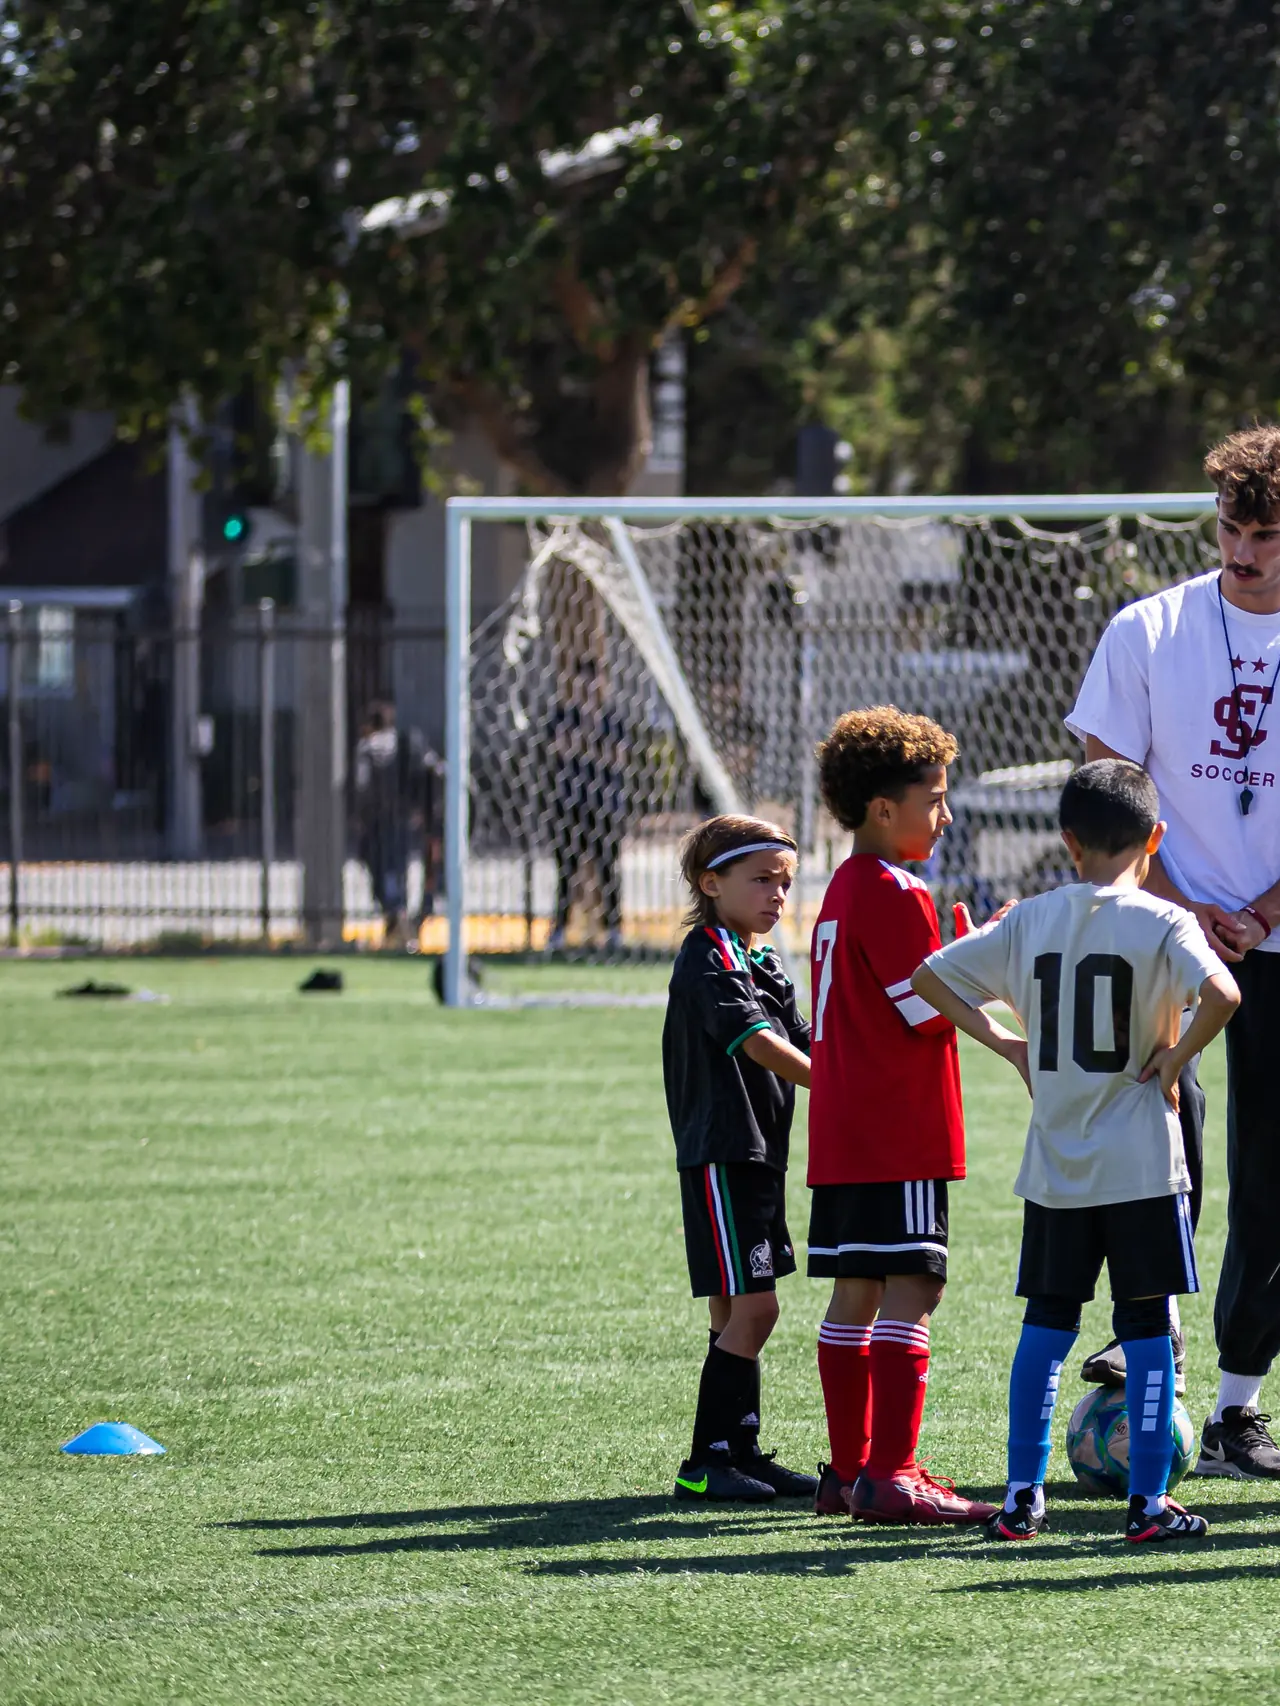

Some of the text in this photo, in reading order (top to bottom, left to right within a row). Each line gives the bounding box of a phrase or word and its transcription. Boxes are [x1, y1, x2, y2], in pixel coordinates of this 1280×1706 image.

[1190, 763, 1276, 787] SOCCER
[814, 919, 838, 1042] 7
[1033, 952, 1134, 1073] 10
